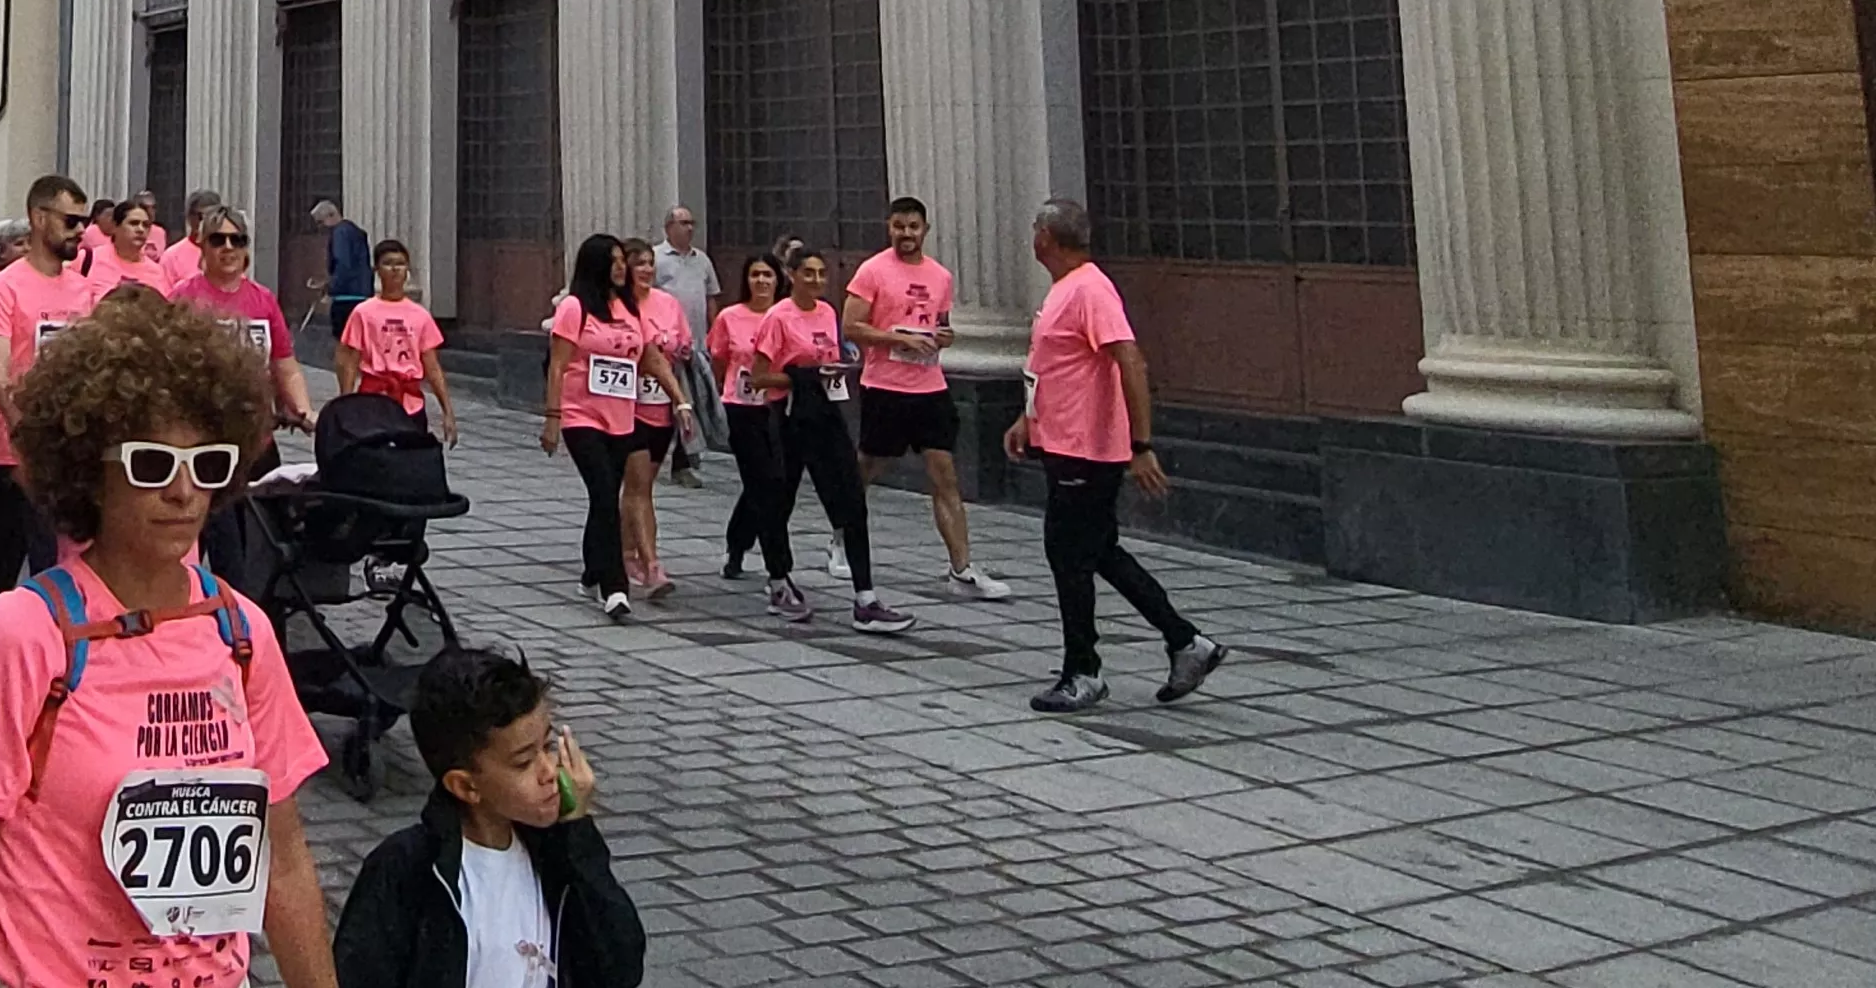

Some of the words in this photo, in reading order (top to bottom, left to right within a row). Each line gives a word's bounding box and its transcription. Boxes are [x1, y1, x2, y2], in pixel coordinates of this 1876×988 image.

[599, 369, 628, 386] 574
[643, 379, 661, 394] 57
[147, 691, 214, 725] CORRAMOS
[136, 725, 161, 758] POR
[165, 724, 178, 757] LA
[181, 719, 230, 756] CIENCIA
[172, 786, 211, 799] HUESCA
[125, 799, 180, 818] CONTRA
[182, 799, 197, 815] EL
[200, 796, 258, 815] CÁNCER
[119, 824, 254, 889] 2706
